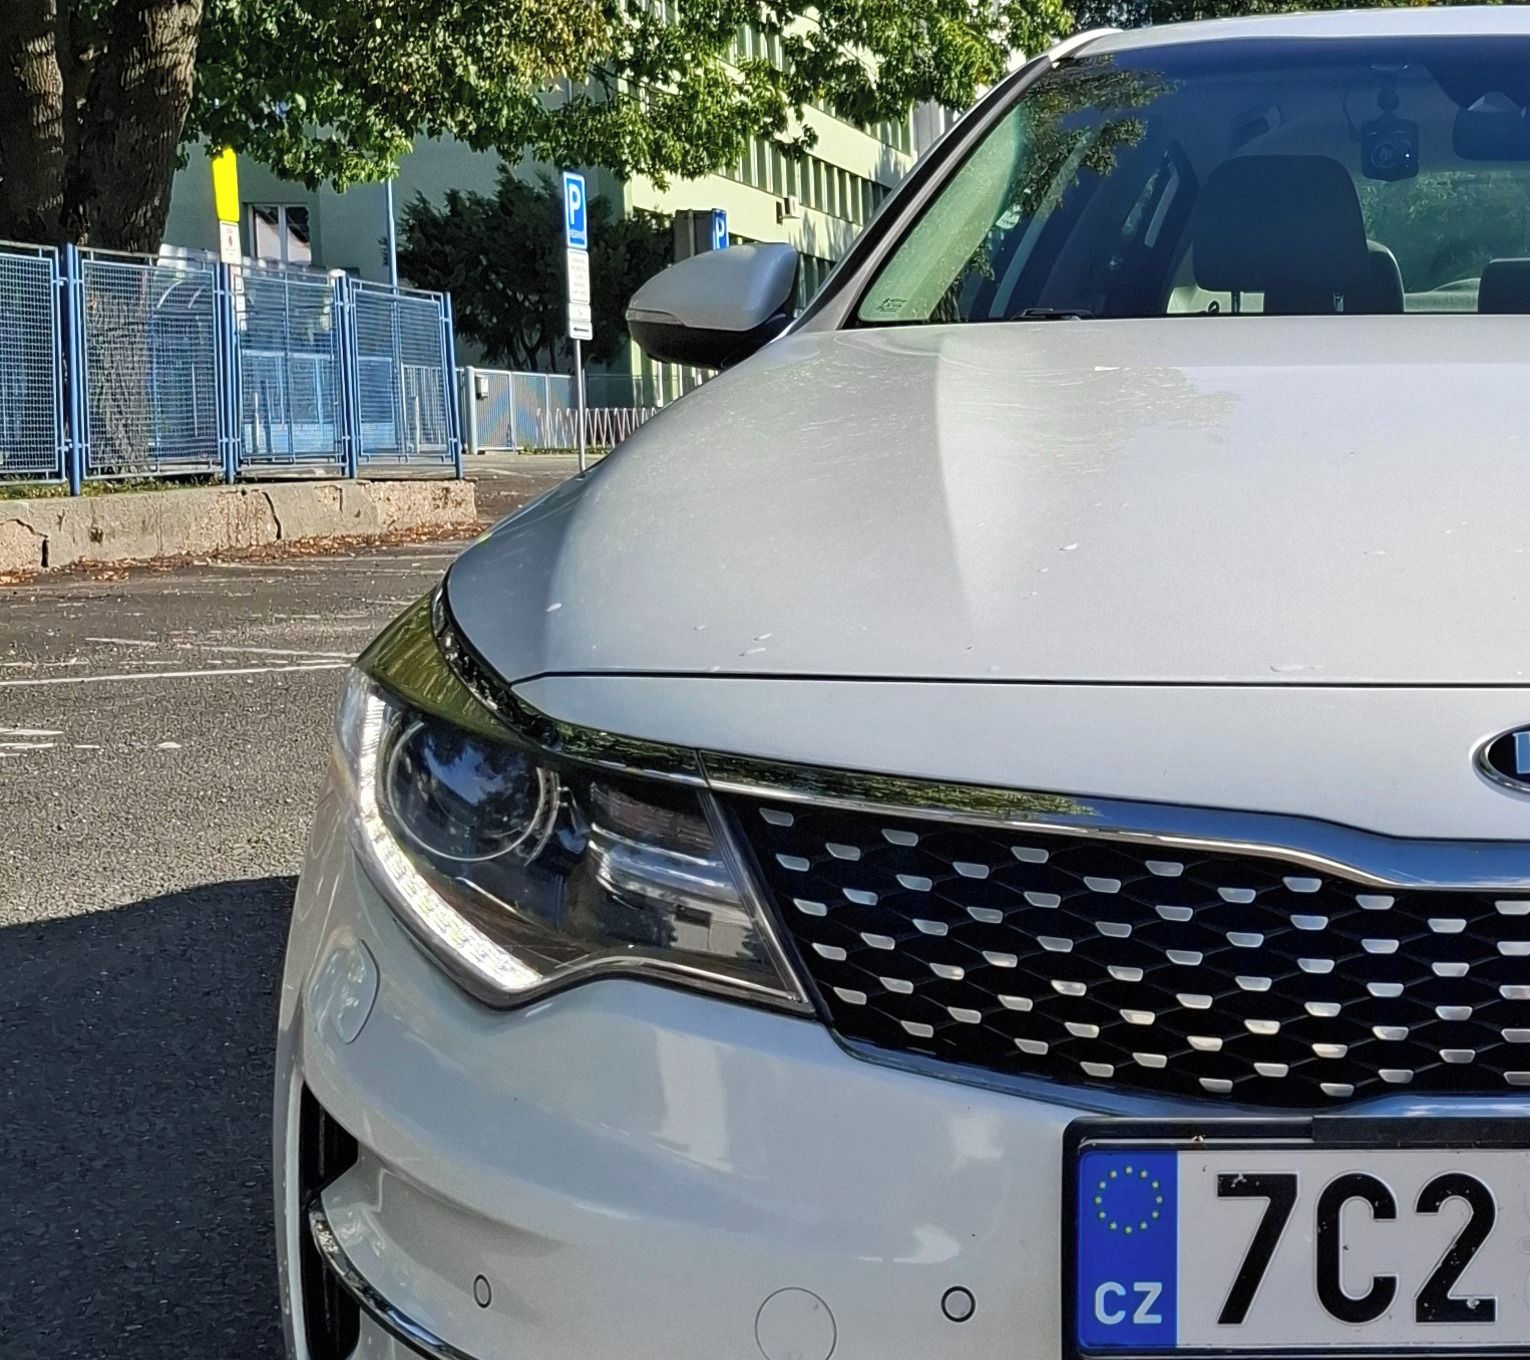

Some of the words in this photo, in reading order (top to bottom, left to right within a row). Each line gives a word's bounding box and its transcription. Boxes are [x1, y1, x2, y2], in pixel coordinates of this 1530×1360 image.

[569, 183, 581, 225] P
[715, 216, 725, 250] P
[1217, 1172, 1497, 1325] 7C2
[1093, 1281, 1163, 1327] CZ
